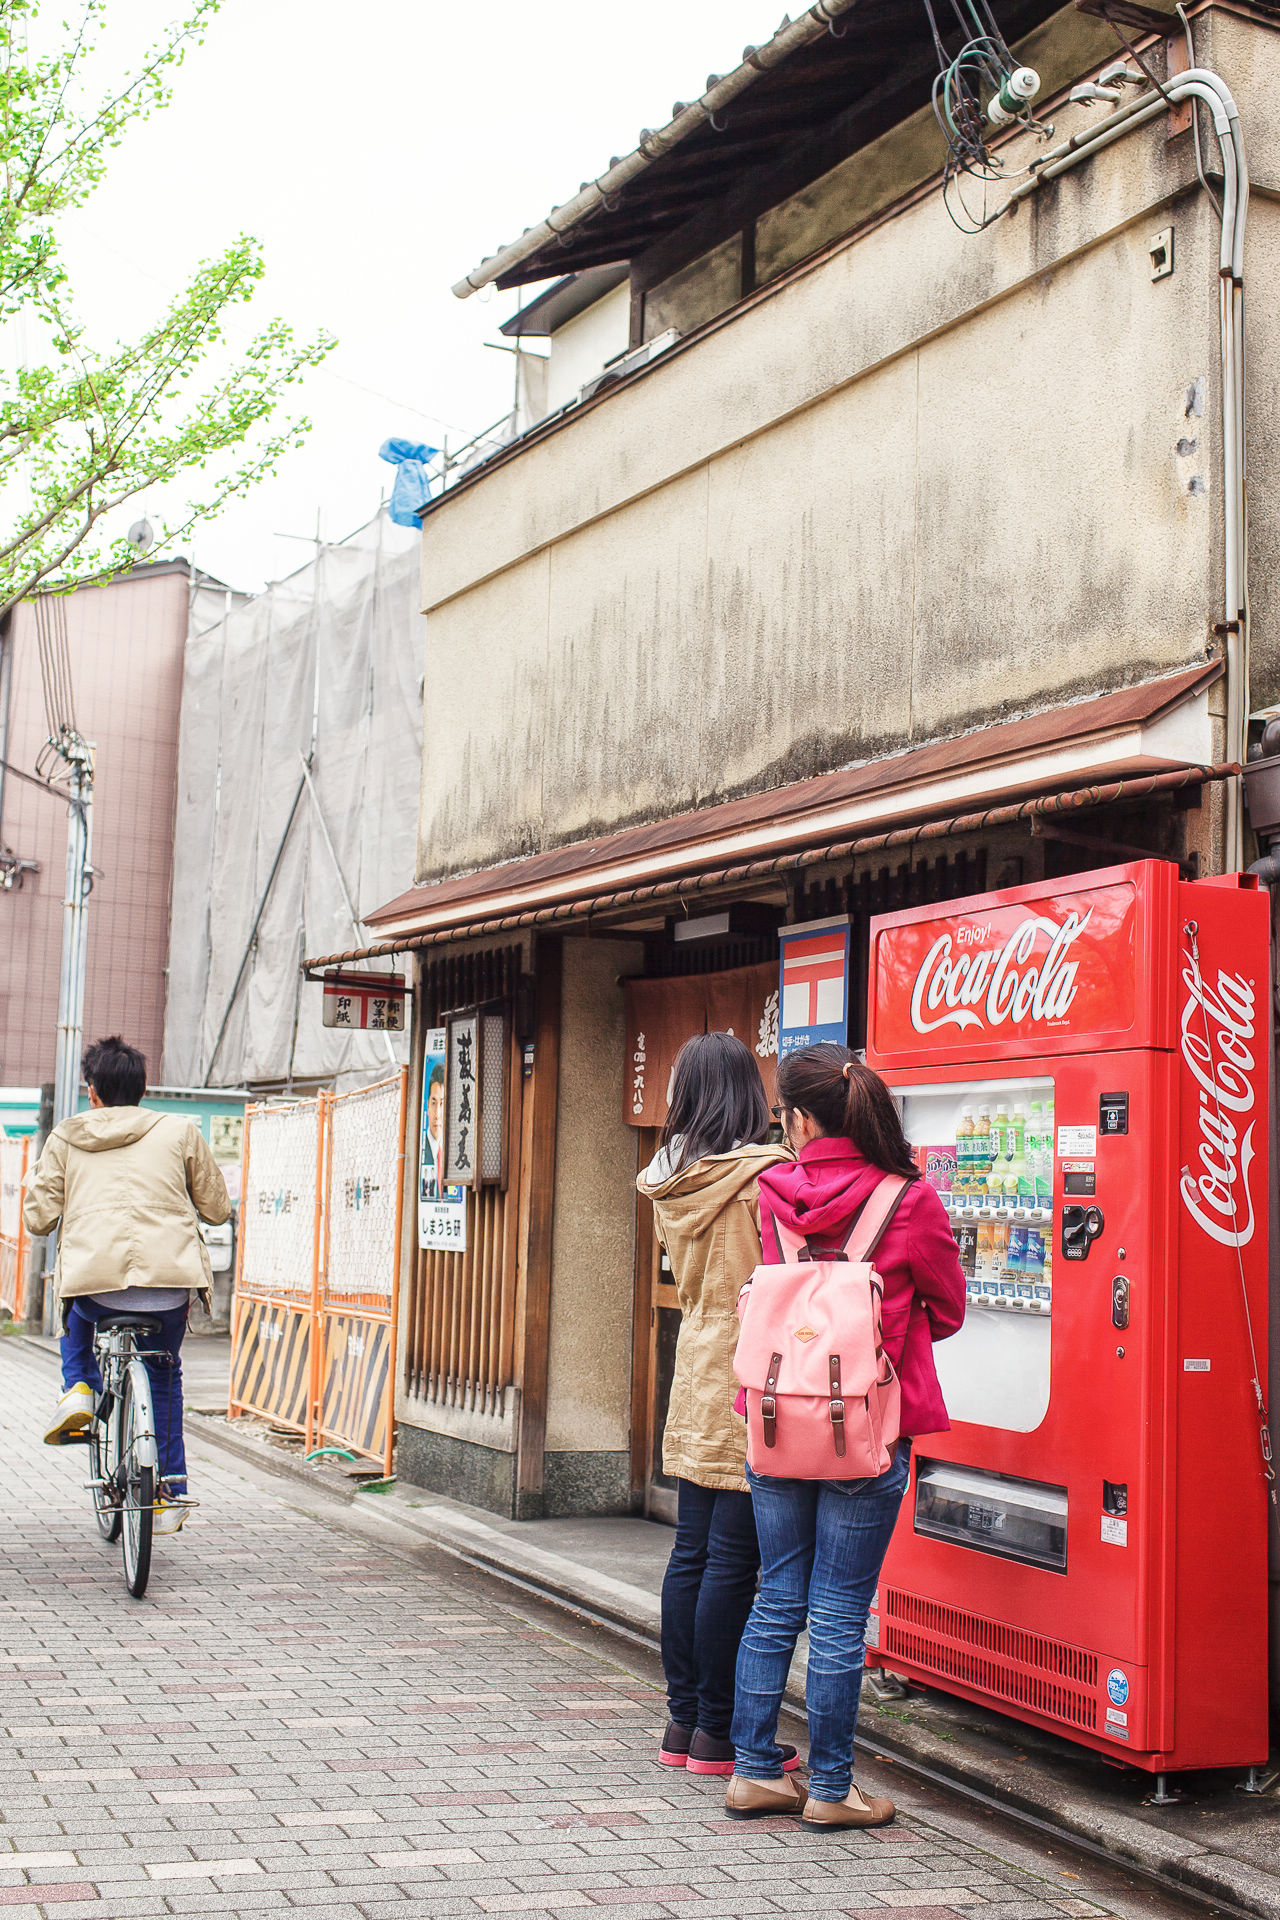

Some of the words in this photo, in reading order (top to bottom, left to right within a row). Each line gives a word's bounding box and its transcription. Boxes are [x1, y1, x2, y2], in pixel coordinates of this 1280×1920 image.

[910, 904, 1095, 1034] Coca-Cola
[957, 923, 991, 945] Enjoy!
[336, 996, 351, 1023] 印紙
[1180, 948, 1256, 1247] Coca-Cola
